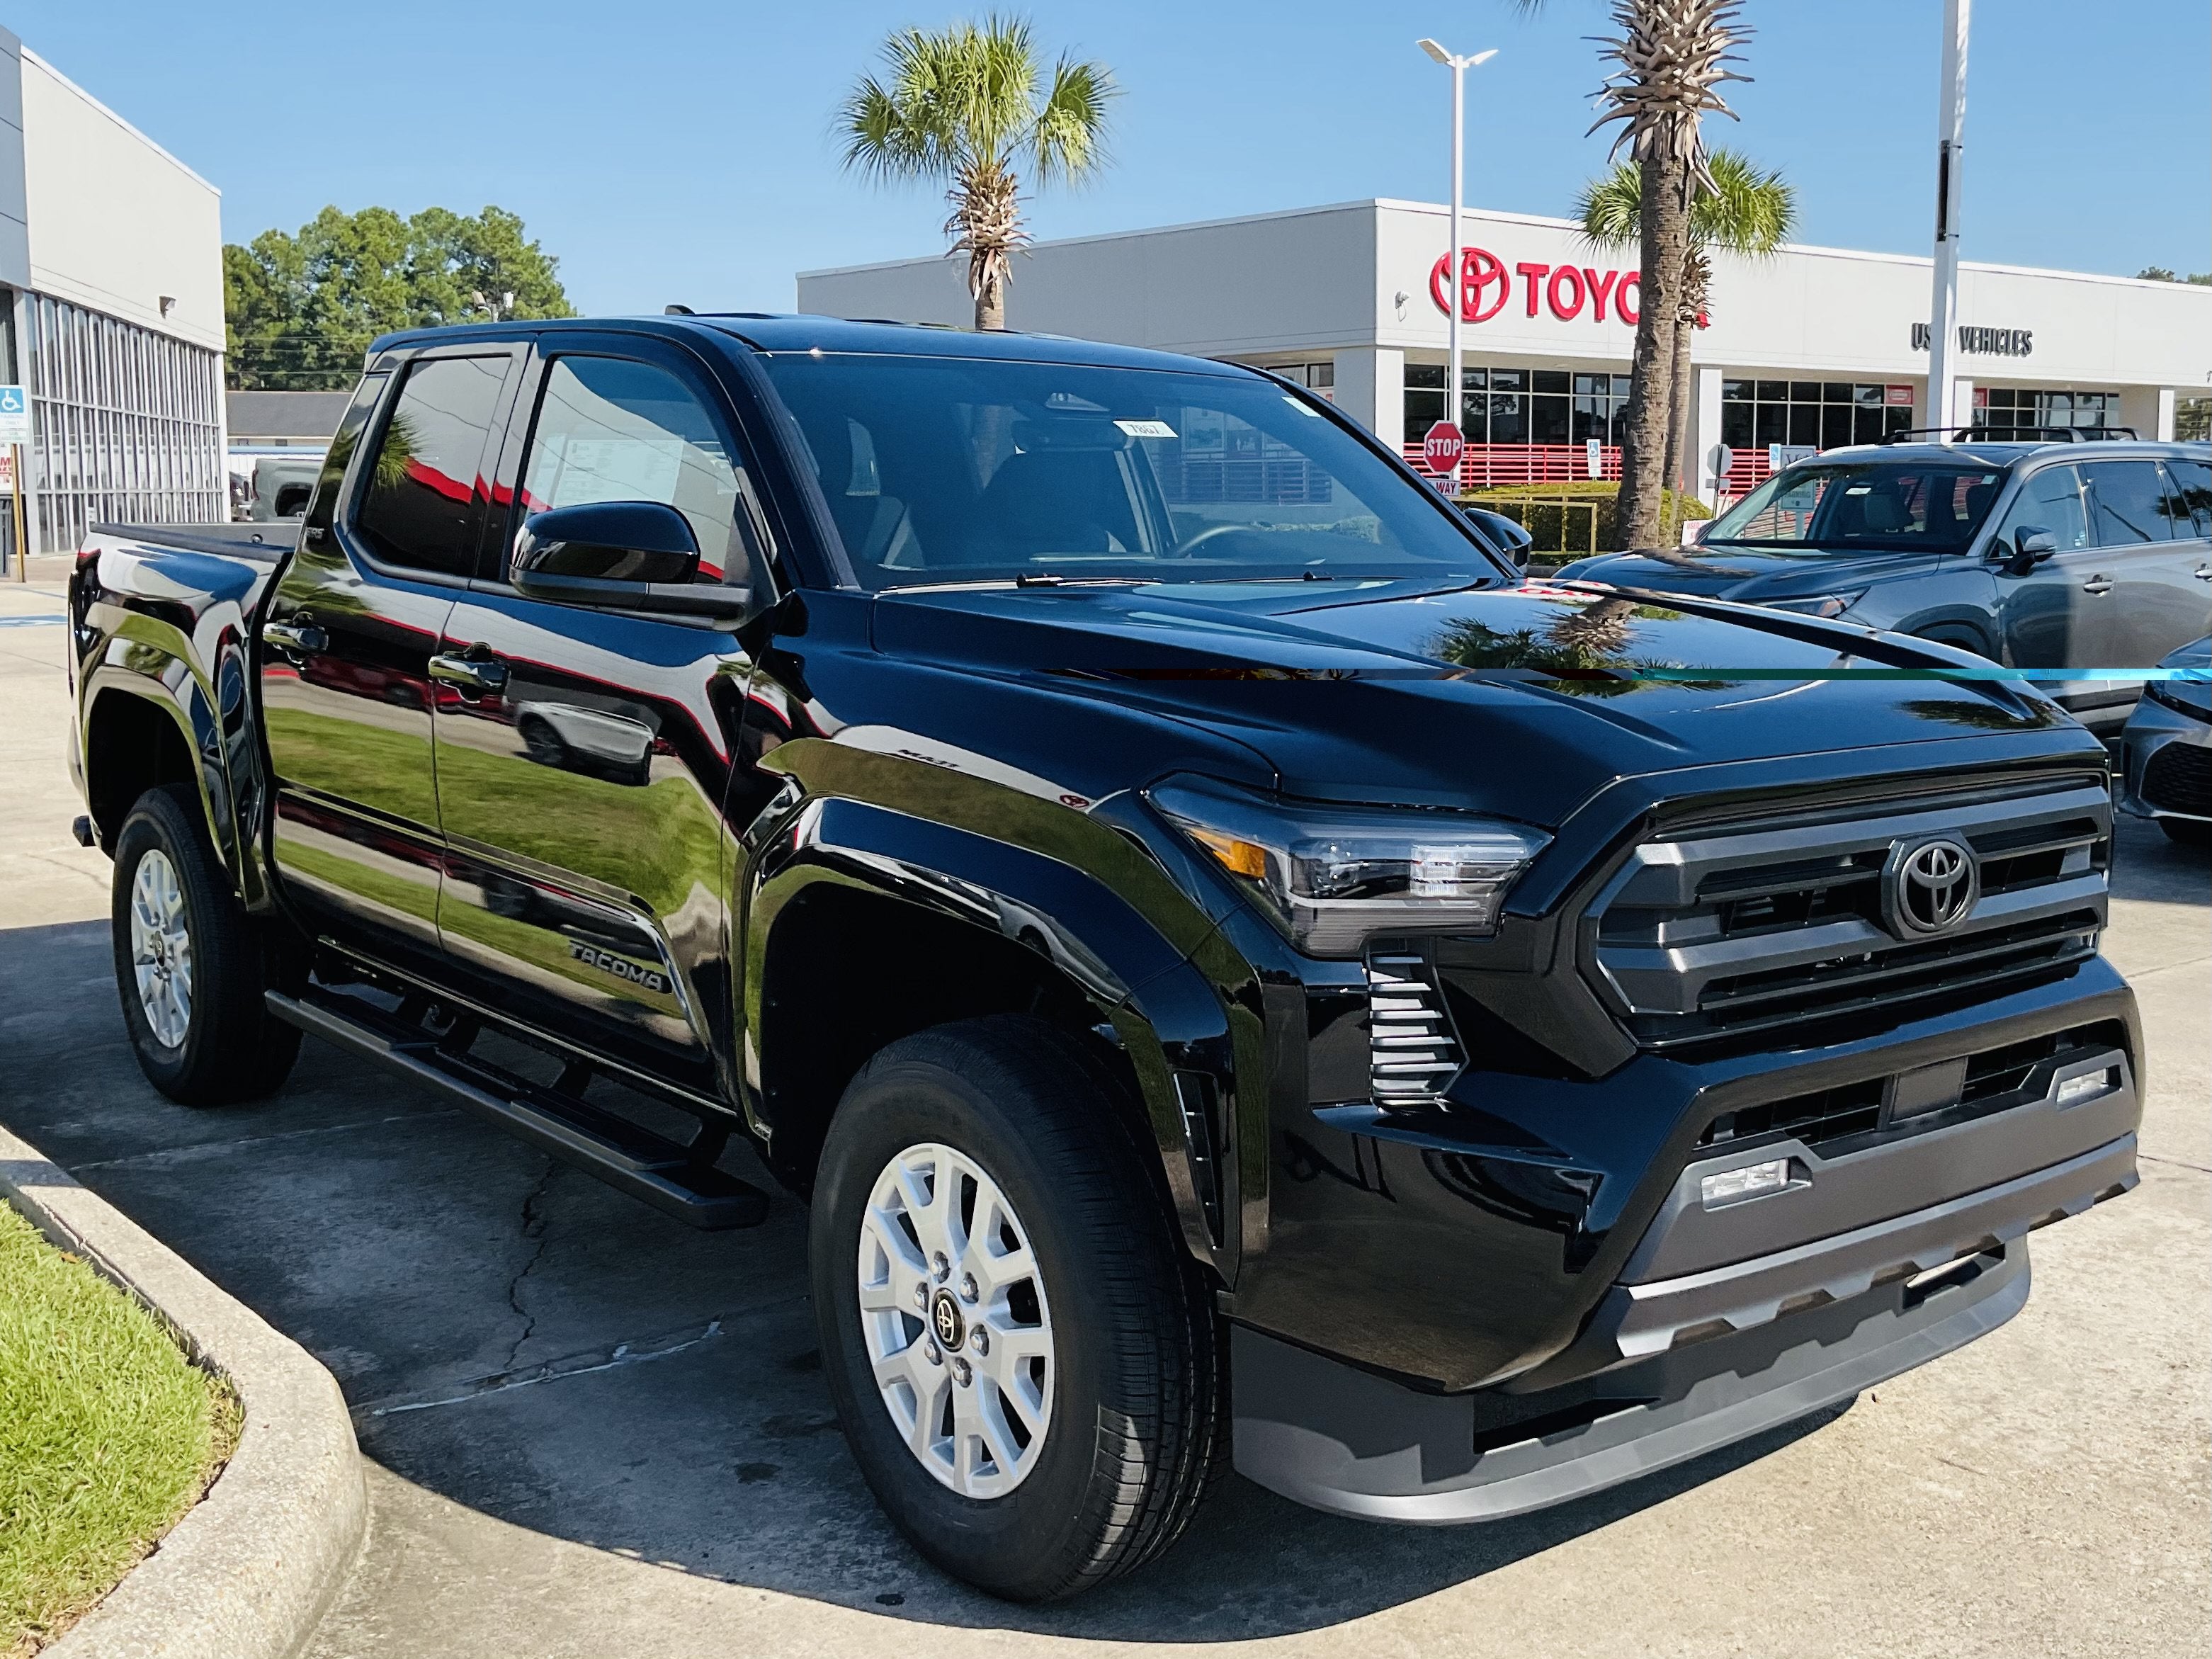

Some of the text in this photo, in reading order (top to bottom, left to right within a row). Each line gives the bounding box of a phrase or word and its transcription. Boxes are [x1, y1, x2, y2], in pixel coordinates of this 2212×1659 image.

[1516, 262, 1711, 329] TOYO
[1959, 326, 2032, 358] VEHICLES
[1427, 438, 1461, 457] STOP
[1436, 482, 1456, 494] WAY
[569, 941, 664, 992] TACOMA
